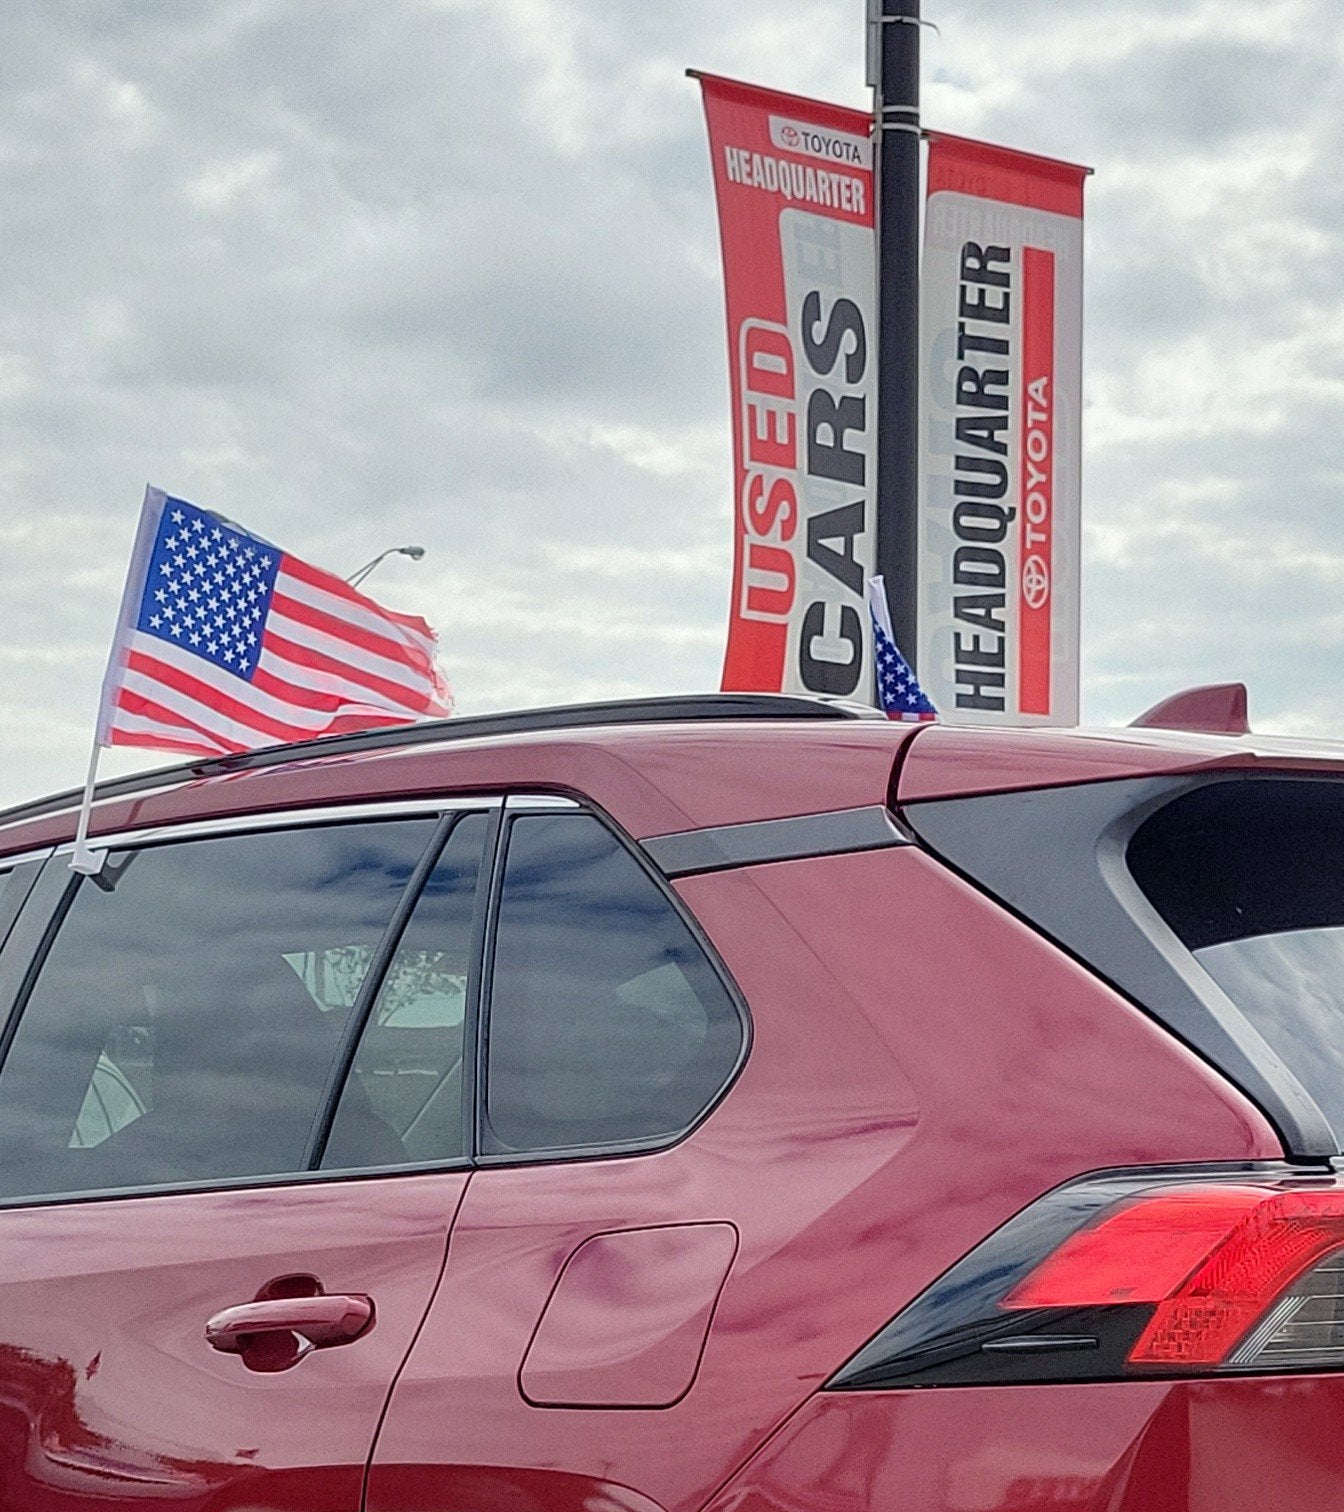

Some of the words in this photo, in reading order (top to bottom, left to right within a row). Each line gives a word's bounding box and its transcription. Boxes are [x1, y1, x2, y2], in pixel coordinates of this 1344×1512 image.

[724, 145, 866, 215] HEADQUARTER
[801, 131, 862, 165] TOYOTA
[739, 317, 798, 624] USED
[799, 290, 867, 696] CARS
[953, 241, 1016, 712] HEADQUARTER
[1026, 376, 1049, 548] TOYOTA
